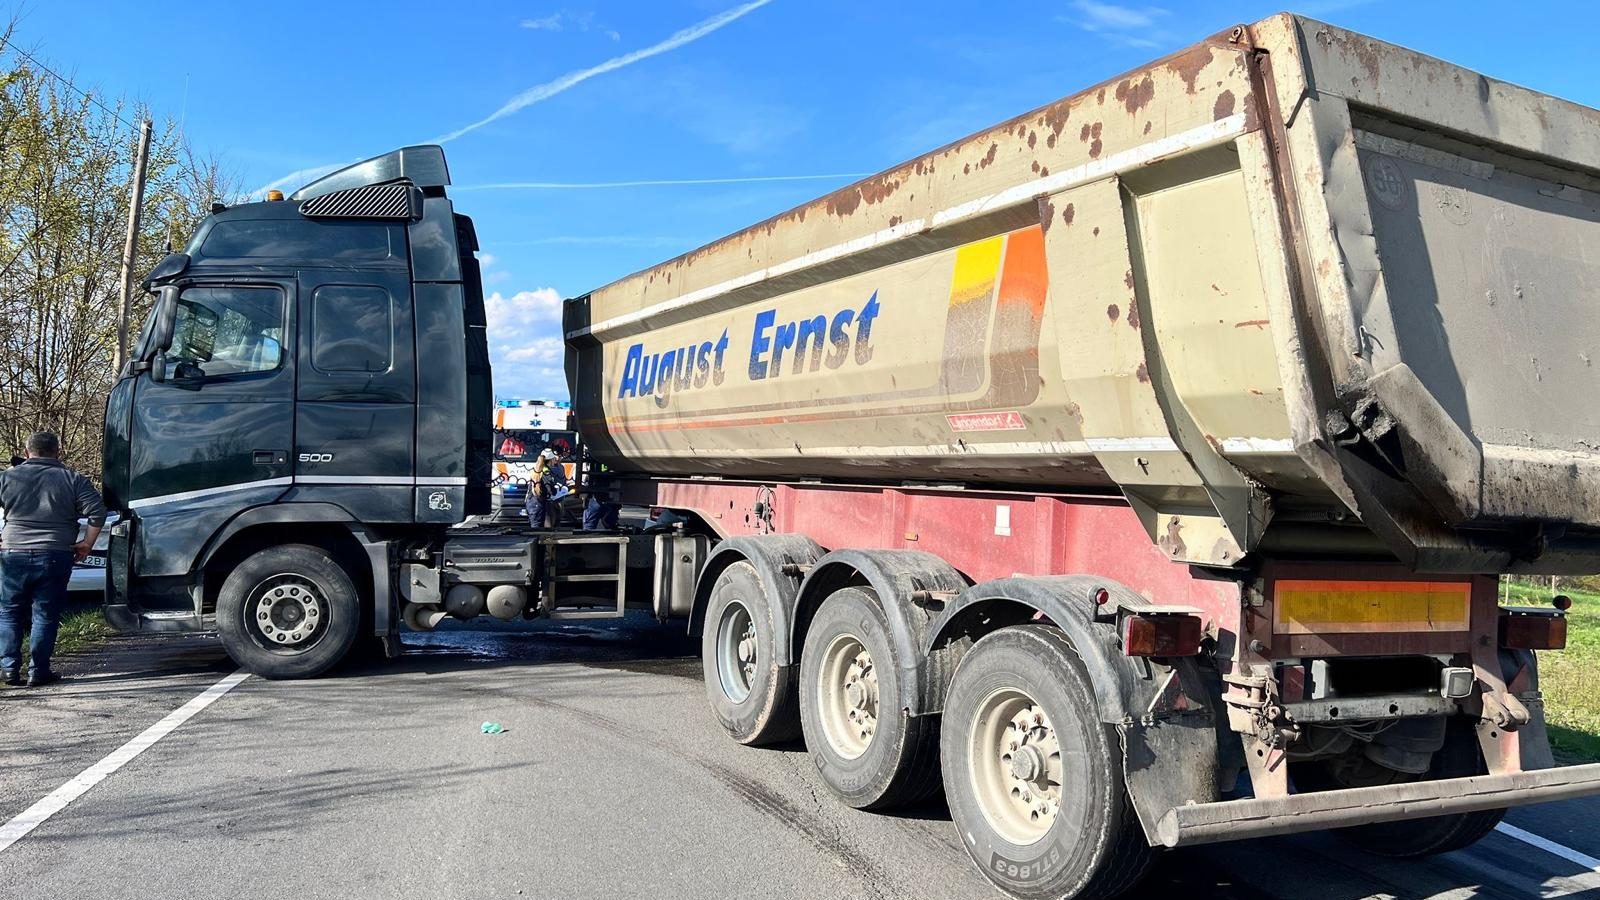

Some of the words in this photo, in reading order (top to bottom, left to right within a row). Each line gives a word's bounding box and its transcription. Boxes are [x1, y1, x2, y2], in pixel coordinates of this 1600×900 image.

[618, 327, 729, 409] August
[748, 288, 881, 381] Ernst
[299, 453, 333, 462] 500
